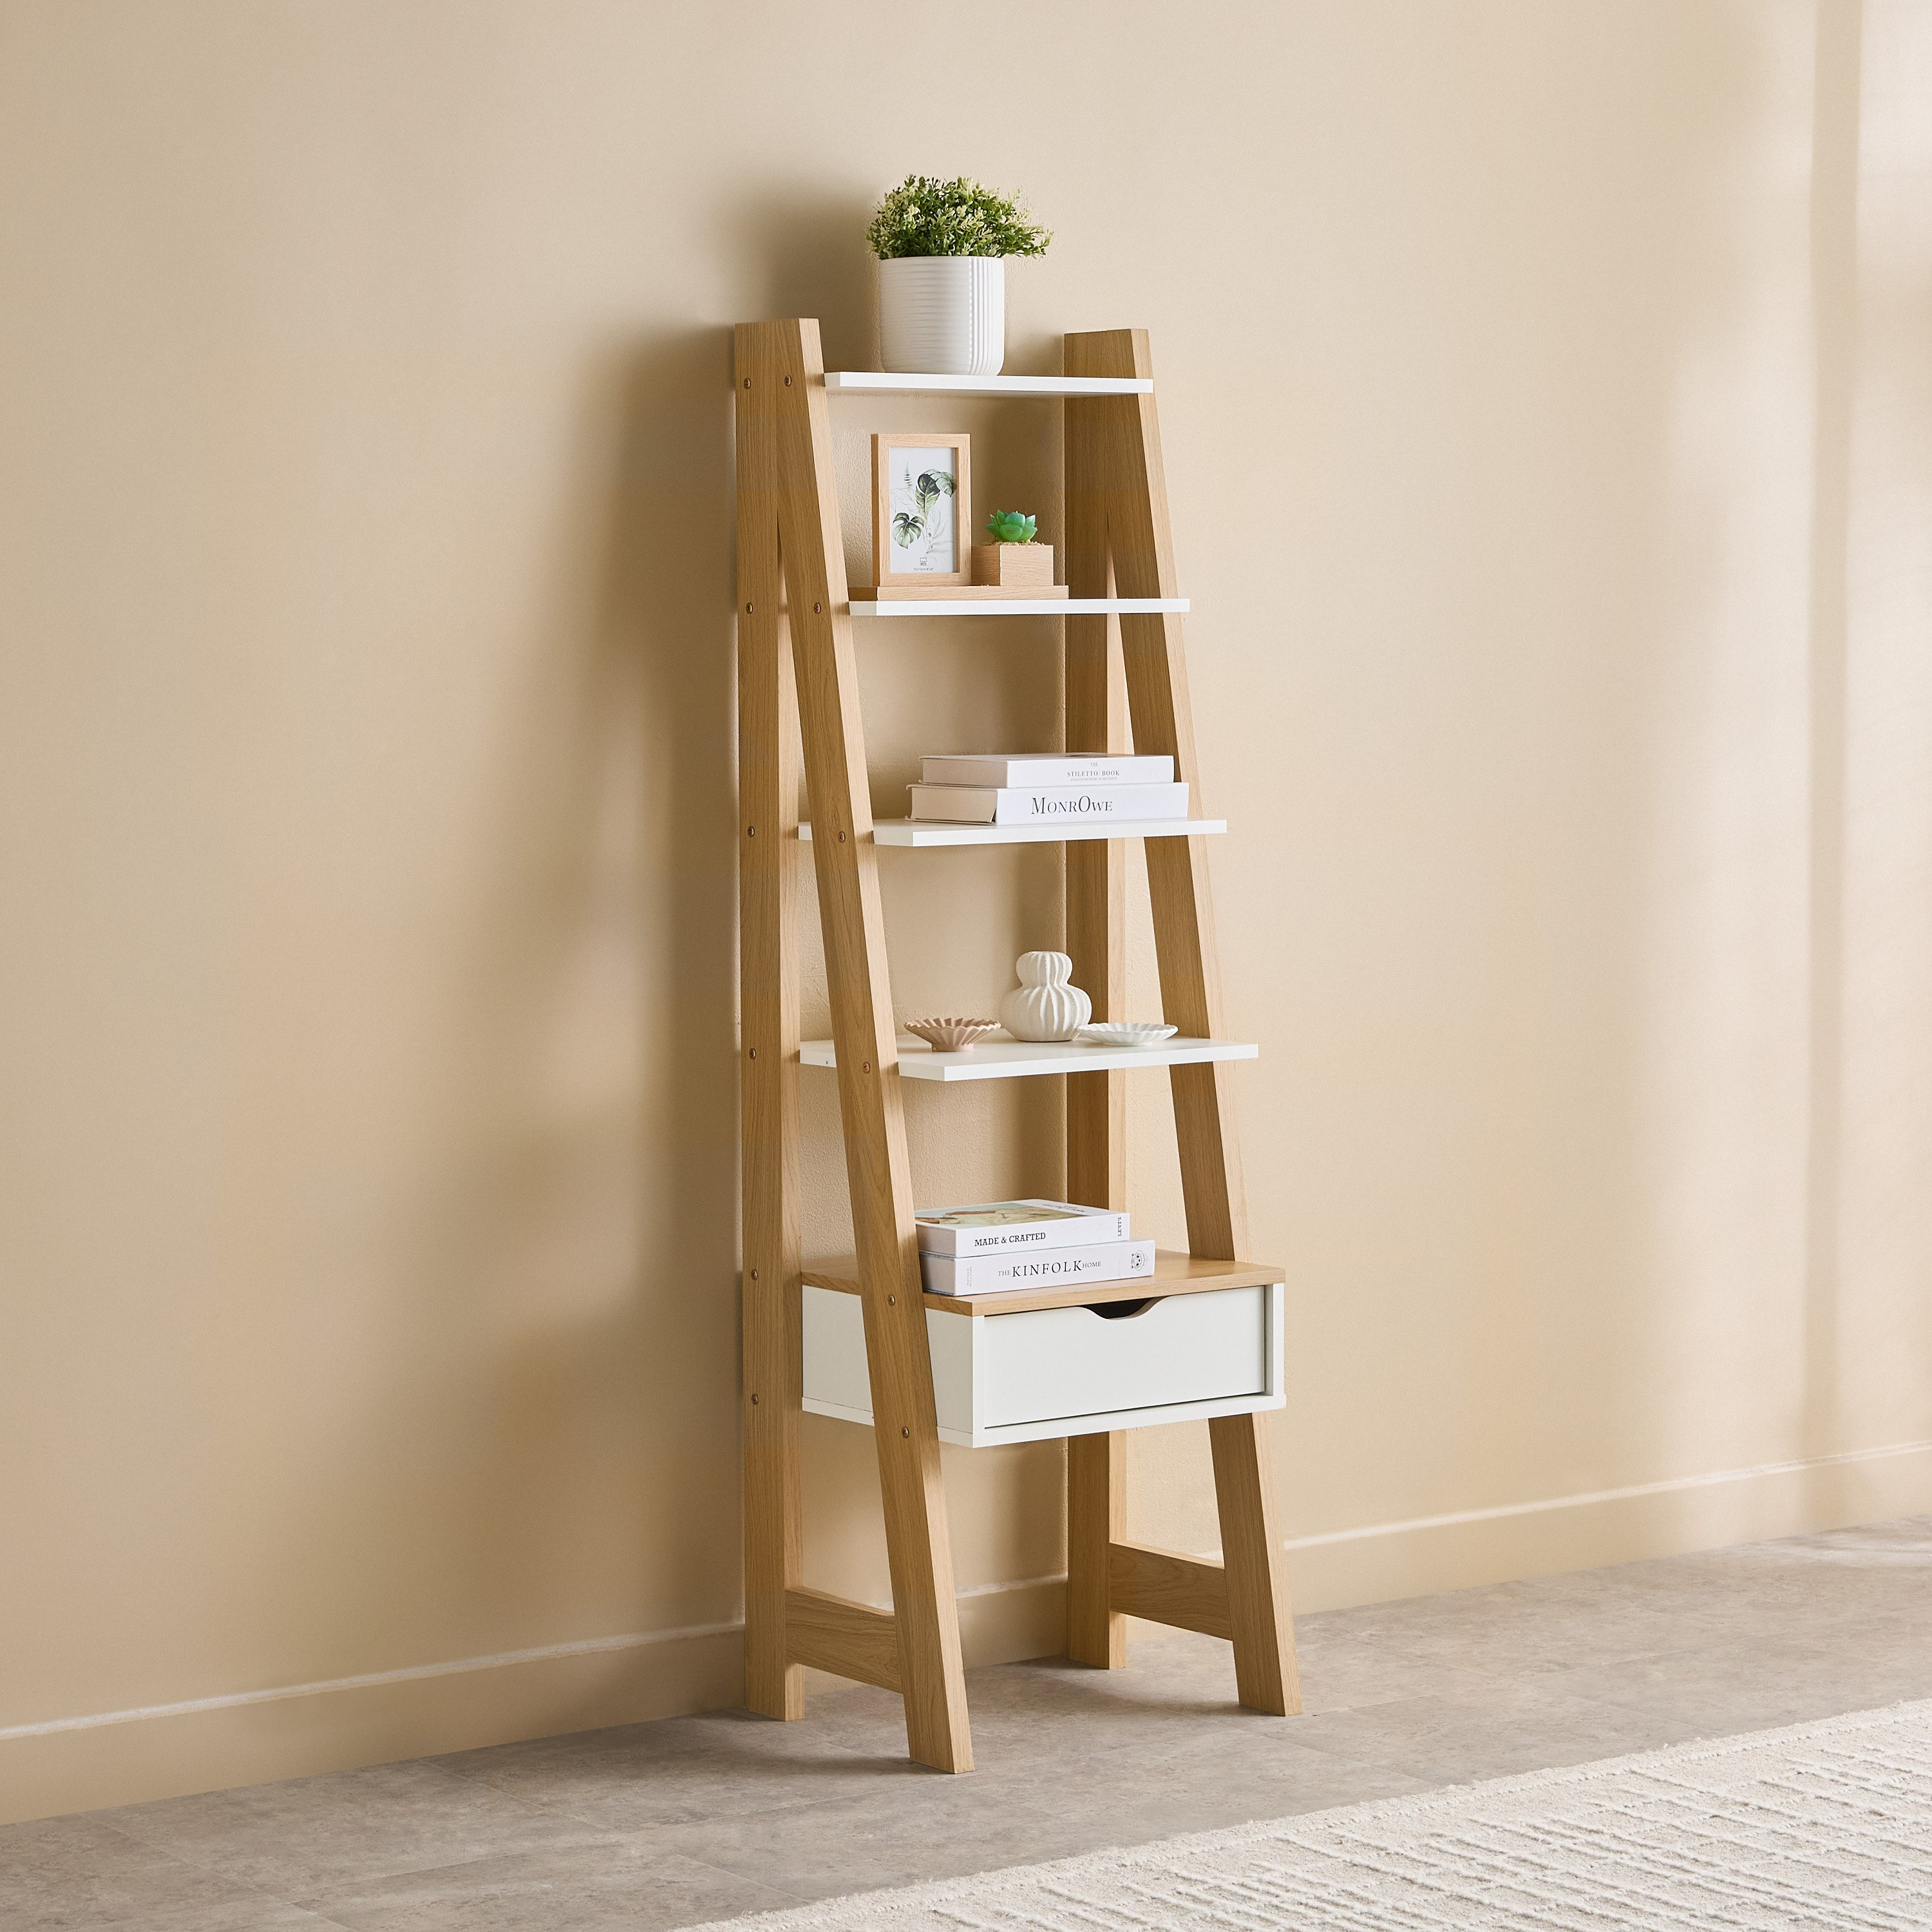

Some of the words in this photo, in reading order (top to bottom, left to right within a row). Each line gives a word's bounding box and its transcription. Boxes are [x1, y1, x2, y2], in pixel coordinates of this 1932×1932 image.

[974, 1238, 999, 1246] MADE
[1009, 1232, 1046, 1243] CRAFTED
[1012, 1260, 1082, 1277] KINFOLK
